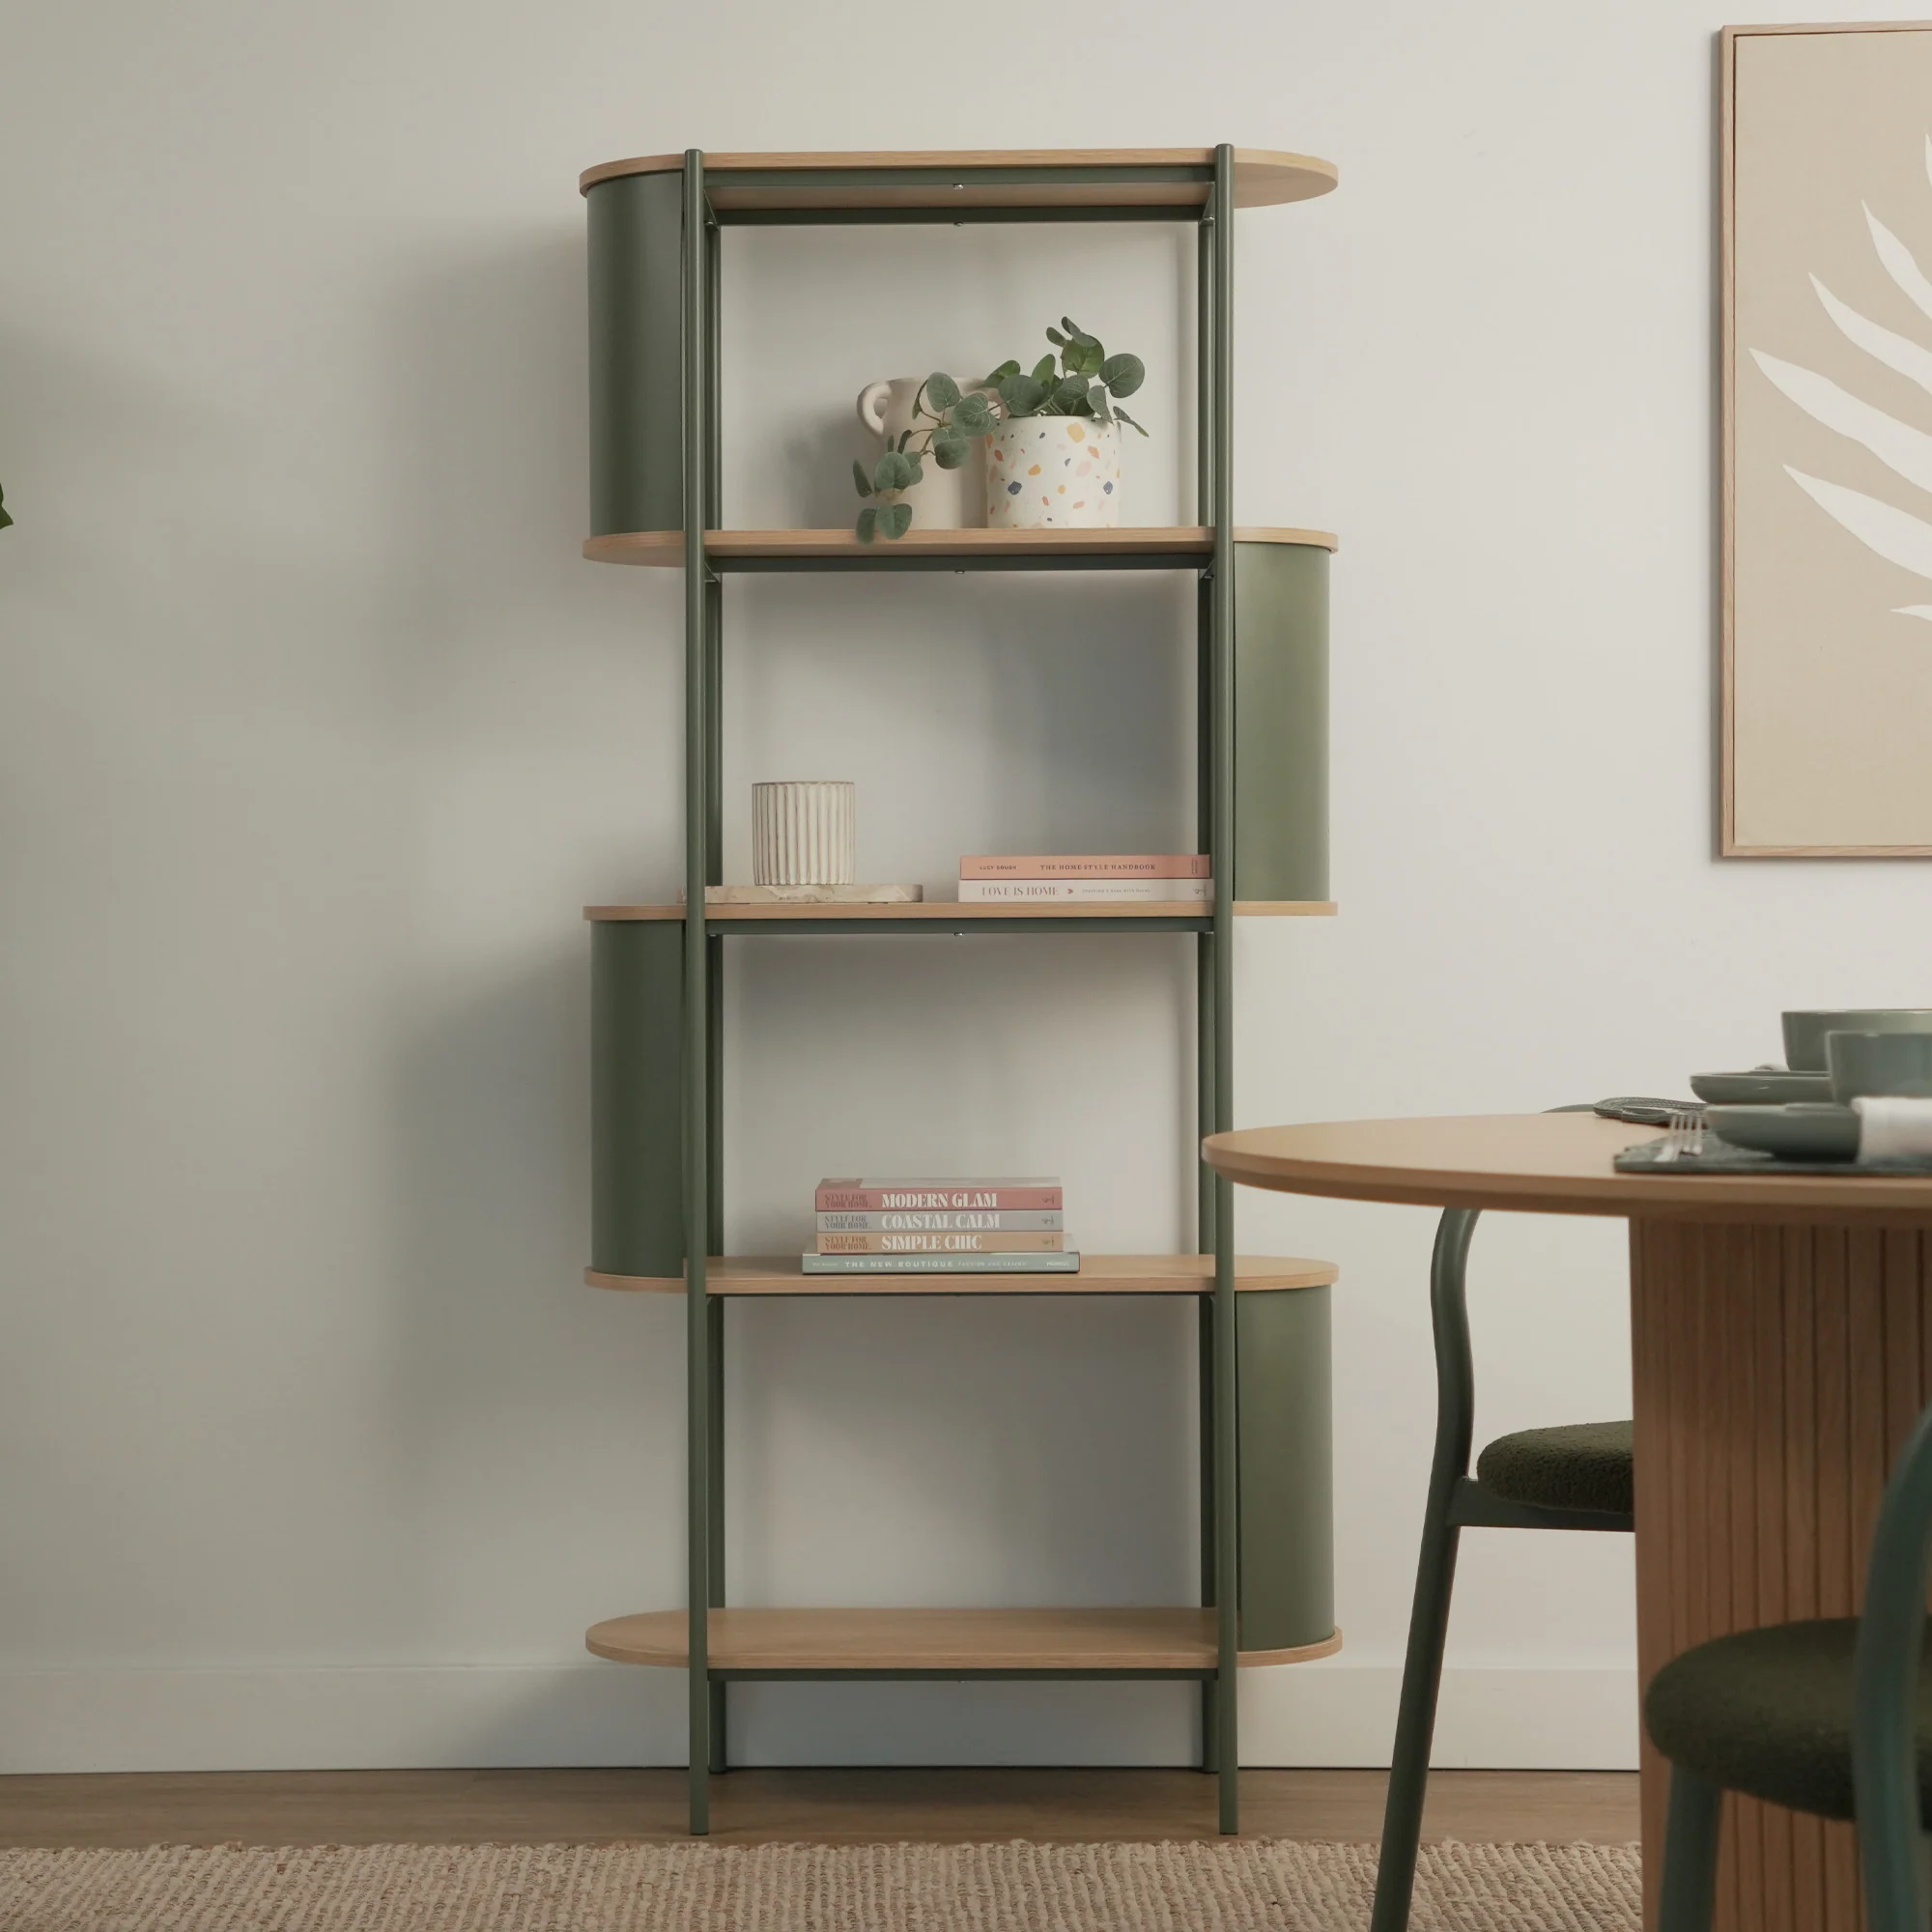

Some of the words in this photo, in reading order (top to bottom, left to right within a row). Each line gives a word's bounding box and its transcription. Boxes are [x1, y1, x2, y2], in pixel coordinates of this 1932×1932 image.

[981, 886, 1009, 896] LOVE
[1013, 886, 1024, 896] IS
[1027, 886, 1060, 896] HOME
[881, 1192, 949, 1208] MODERN
[952, 1192, 998, 1208] GLAM
[881, 1212, 953, 1230] COASTAL
[955, 1212, 1001, 1230] CALM
[881, 1235, 942, 1251] SIMPLE
[944, 1235, 982, 1250] CHIC
